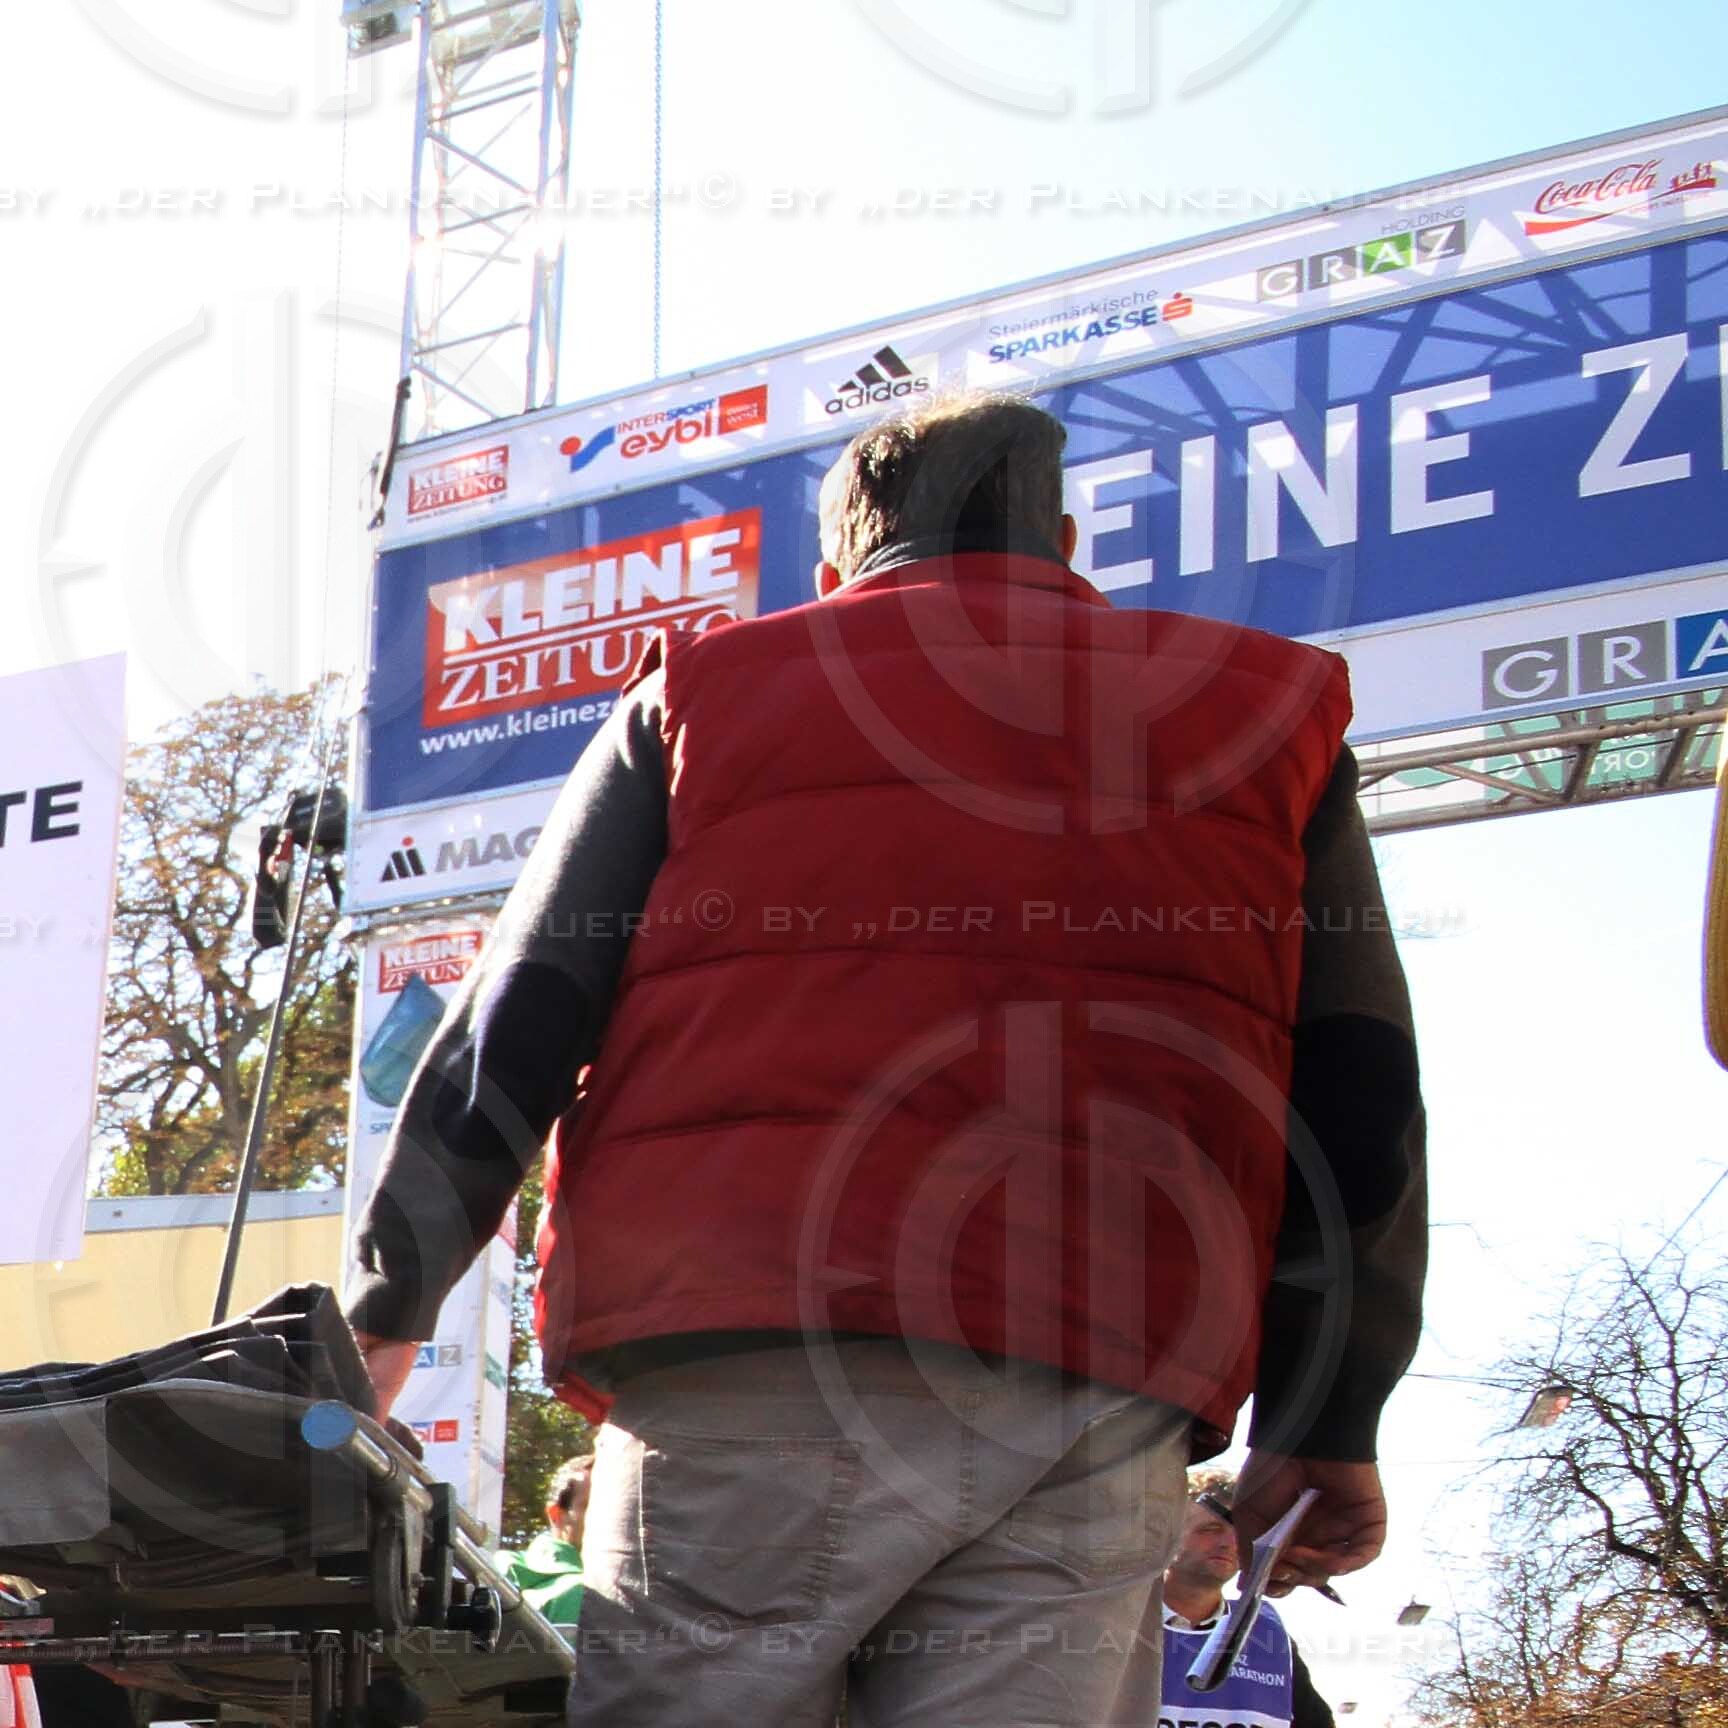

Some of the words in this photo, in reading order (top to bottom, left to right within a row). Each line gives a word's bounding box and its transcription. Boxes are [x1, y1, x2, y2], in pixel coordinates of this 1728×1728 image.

[1380, 204, 1466, 236] HOLDING
[1258, 222, 1458, 299] GRAZ
[989, 287, 1159, 340] Steiermärkische
[989, 304, 1159, 365] SPARKASSE
[617, 397, 719, 433] INTERSPORT
[825, 374, 931, 415] adidas
[619, 412, 713, 460] eybl
[414, 449, 505, 492] KLEINE
[412, 474, 505, 512] ZEITUNG
[441, 527, 742, 654] KLEINE
[383, 934, 478, 969] KLEINE
